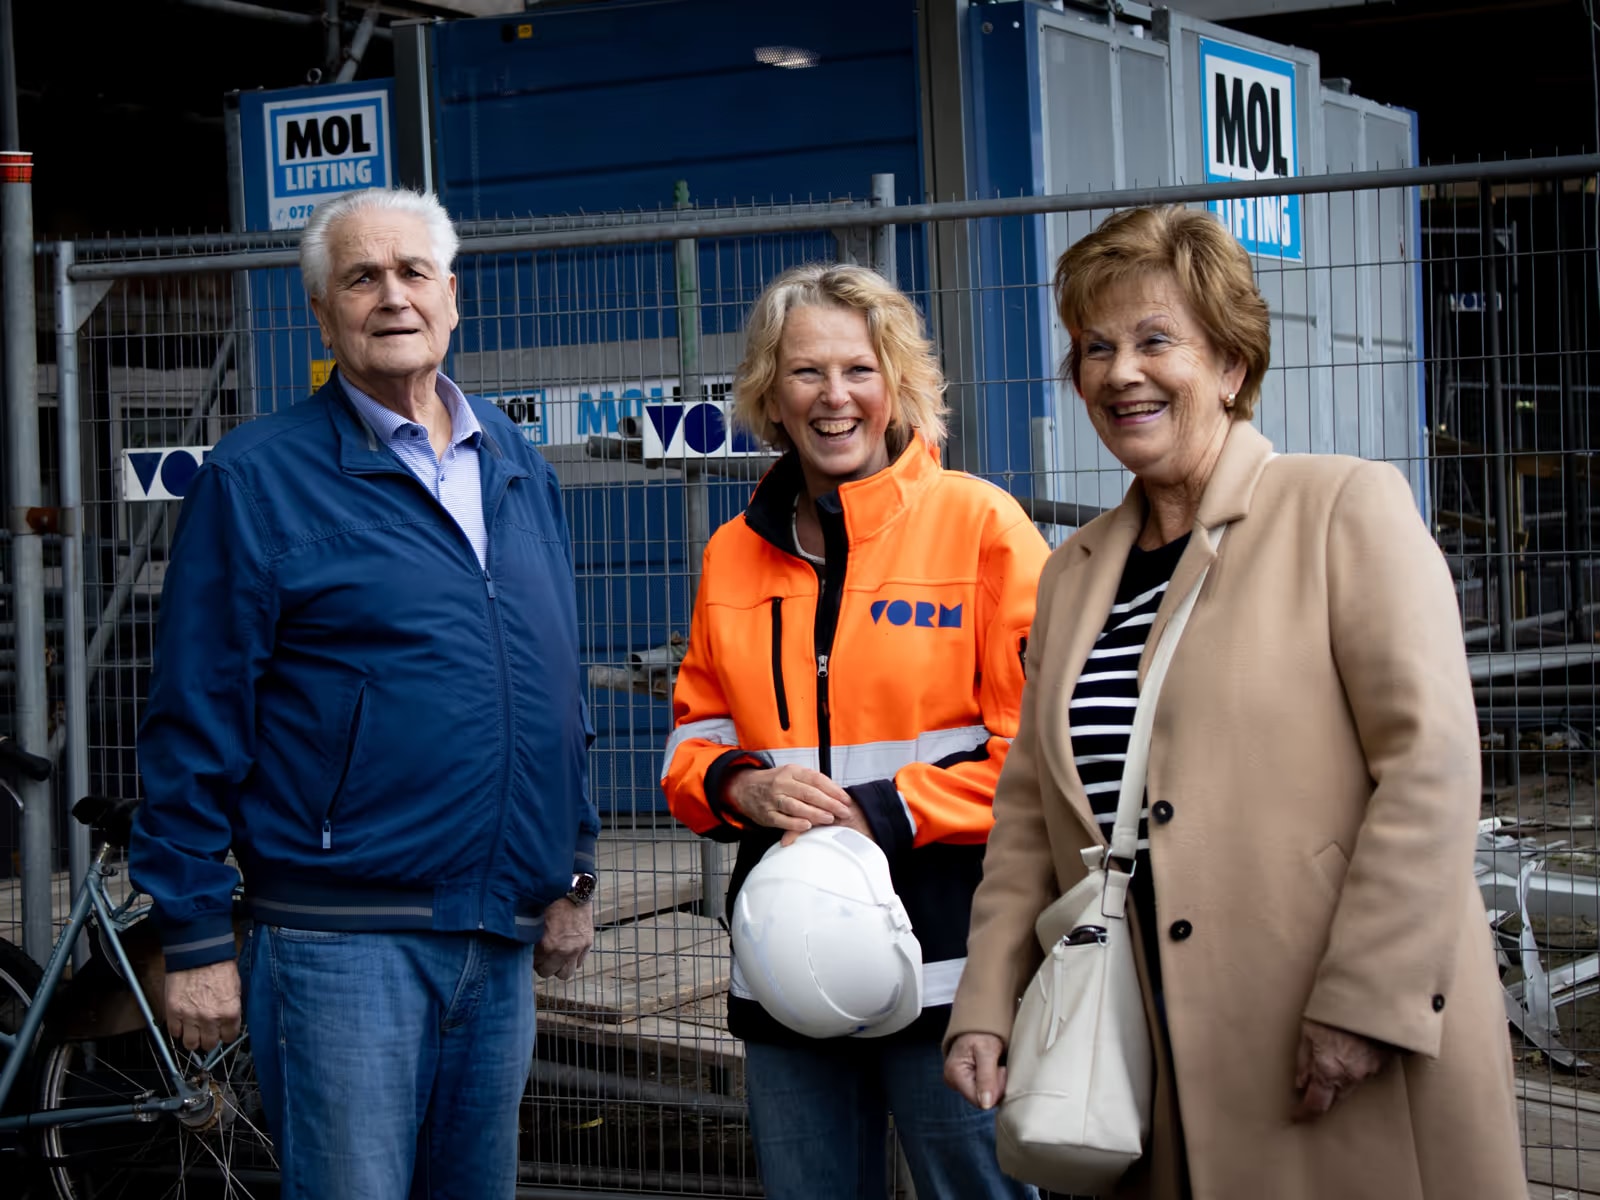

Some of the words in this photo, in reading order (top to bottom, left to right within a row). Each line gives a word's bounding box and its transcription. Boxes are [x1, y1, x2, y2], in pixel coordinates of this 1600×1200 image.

[286, 113, 371, 161] MOL
[1215, 72, 1288, 176] MOL
[285, 159, 372, 191] LIFTING
[870, 599, 962, 628] VORM
